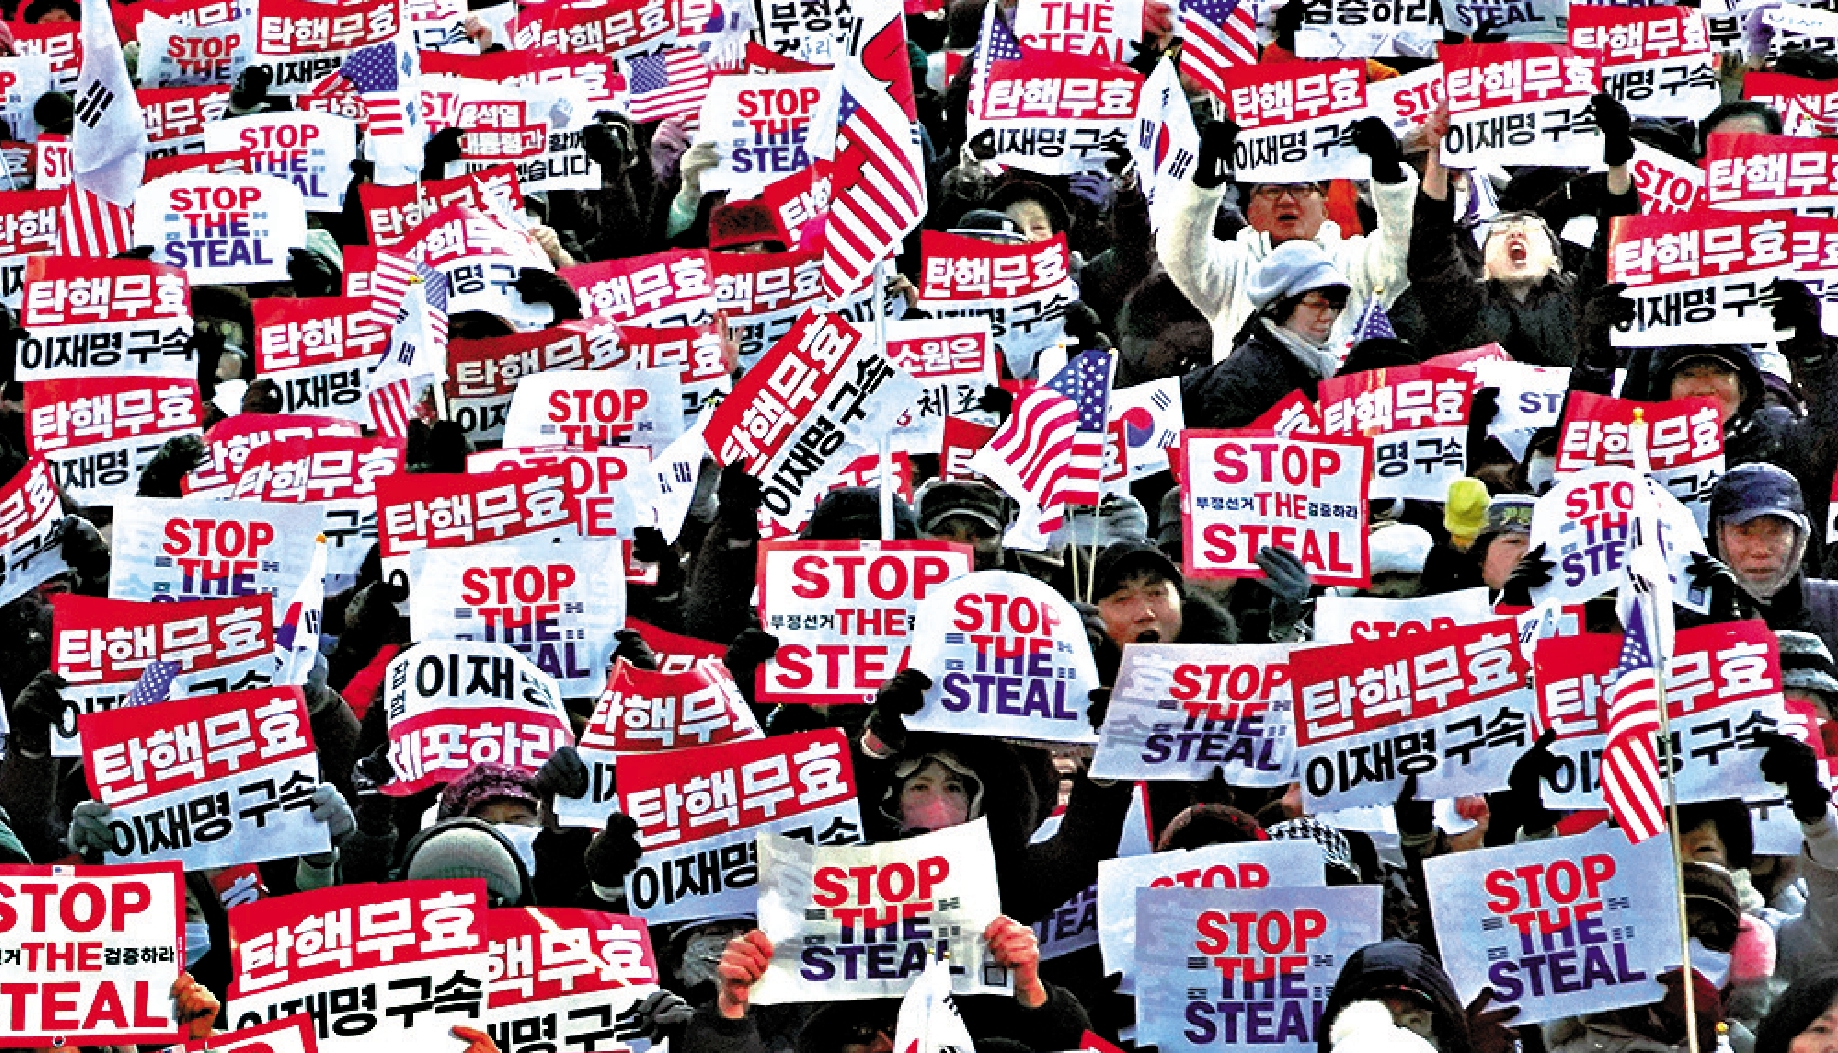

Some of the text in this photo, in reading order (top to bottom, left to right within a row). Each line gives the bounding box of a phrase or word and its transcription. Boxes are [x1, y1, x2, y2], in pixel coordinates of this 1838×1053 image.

[169, 35, 240, 60] STOP
[261, 4, 398, 50] 탄핵무효
[1573, 11, 1708, 52] 탄핵무효
[992, 78, 1136, 120] 탄핵무효
[1232, 70, 1363, 125] 탄핵무효
[1446, 53, 1599, 102] 탄핵무효
[738, 88, 820, 115] STOP
[239, 125, 319, 150] STOP
[751, 118, 810, 142] THE
[1235, 127, 1308, 168] 이재명
[1446, 109, 1536, 153] 이재명
[170, 187, 261, 211] STOP
[188, 212, 249, 238] THE
[165, 240, 273, 268] STEAL
[925, 245, 1066, 299] 탄핵무효
[1614, 218, 1791, 282] 탄핵무효
[27, 271, 188, 325] 탄핵무효
[22, 325, 193, 368] 이재명 구속
[549, 390, 648, 425] STOP
[1213, 444, 1341, 488] STOP
[385, 476, 569, 552] 탄핵무효
[1254, 491, 1307, 519] THE
[163, 518, 274, 557] STOP
[178, 558, 258, 596] THE
[462, 566, 575, 604] STOP
[791, 556, 950, 600] STOP
[478, 602, 560, 642] THE
[770, 609, 909, 637] 부정선거 THE
[953, 594, 1060, 632] STOP
[60, 605, 267, 679] 탄핵무효
[970, 635, 1053, 679] THE
[941, 674, 1077, 721] STEAL
[1299, 636, 1518, 736] 탄핵무효
[92, 698, 306, 802] 탄핵무효
[1307, 709, 1526, 796] 이재명 구속
[627, 741, 850, 838] 탄핵무효
[112, 771, 316, 858] 이재명 구속
[813, 855, 950, 909] STOP
[1484, 853, 1617, 915] STOP
[240, 892, 481, 985] 탄핵무효
[832, 904, 933, 944] THE
[1195, 909, 1326, 955] STOP
[1509, 903, 1606, 953] THE
[27, 942, 103, 972] THE
[104, 947, 174, 965] 검증하라
[1213, 955, 1309, 1000] THE
[1488, 944, 1646, 1003] STEAL
[387, 970, 484, 1032] 구속
